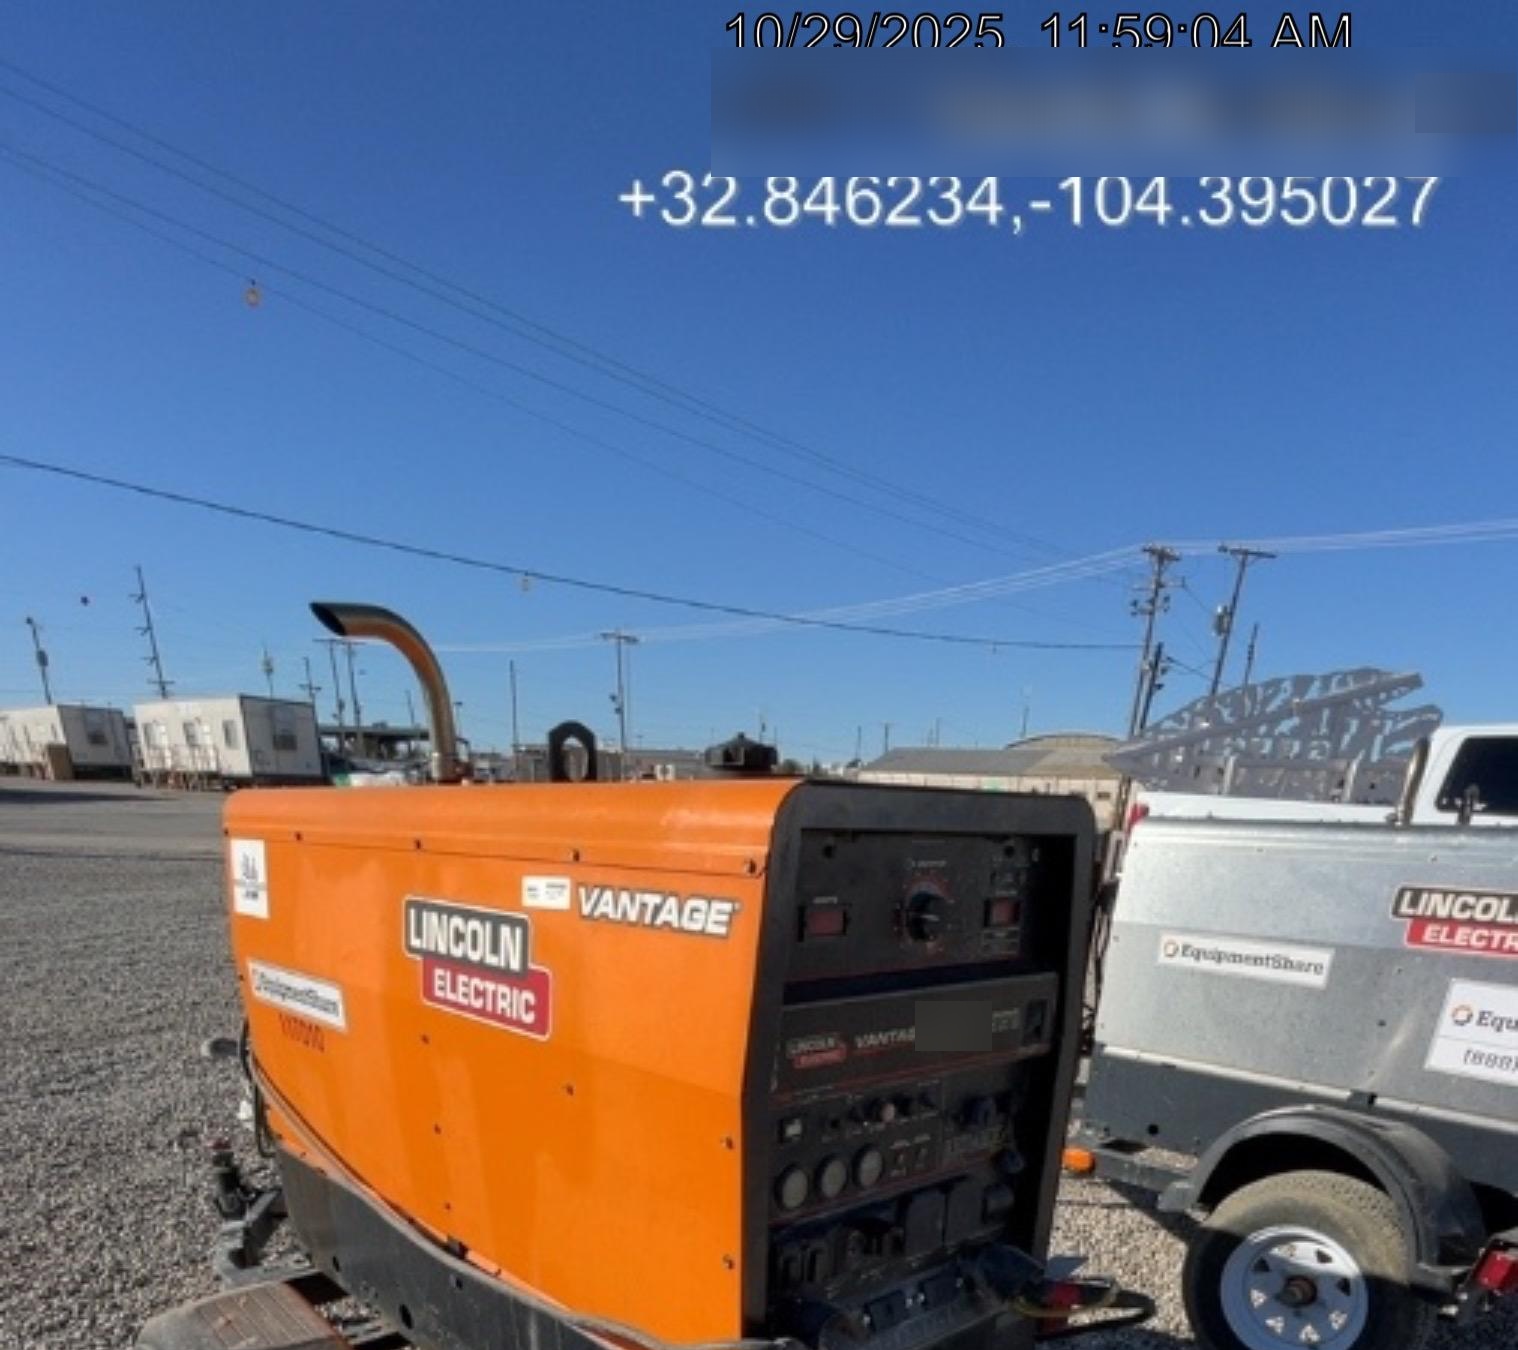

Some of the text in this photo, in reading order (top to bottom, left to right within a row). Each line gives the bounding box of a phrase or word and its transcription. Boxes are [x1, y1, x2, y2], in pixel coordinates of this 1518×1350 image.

[409, 907, 524, 972] LINCOLN
[577, 885, 737, 937] VANTAGE
[433, 967, 537, 1025] ELECTRIC
